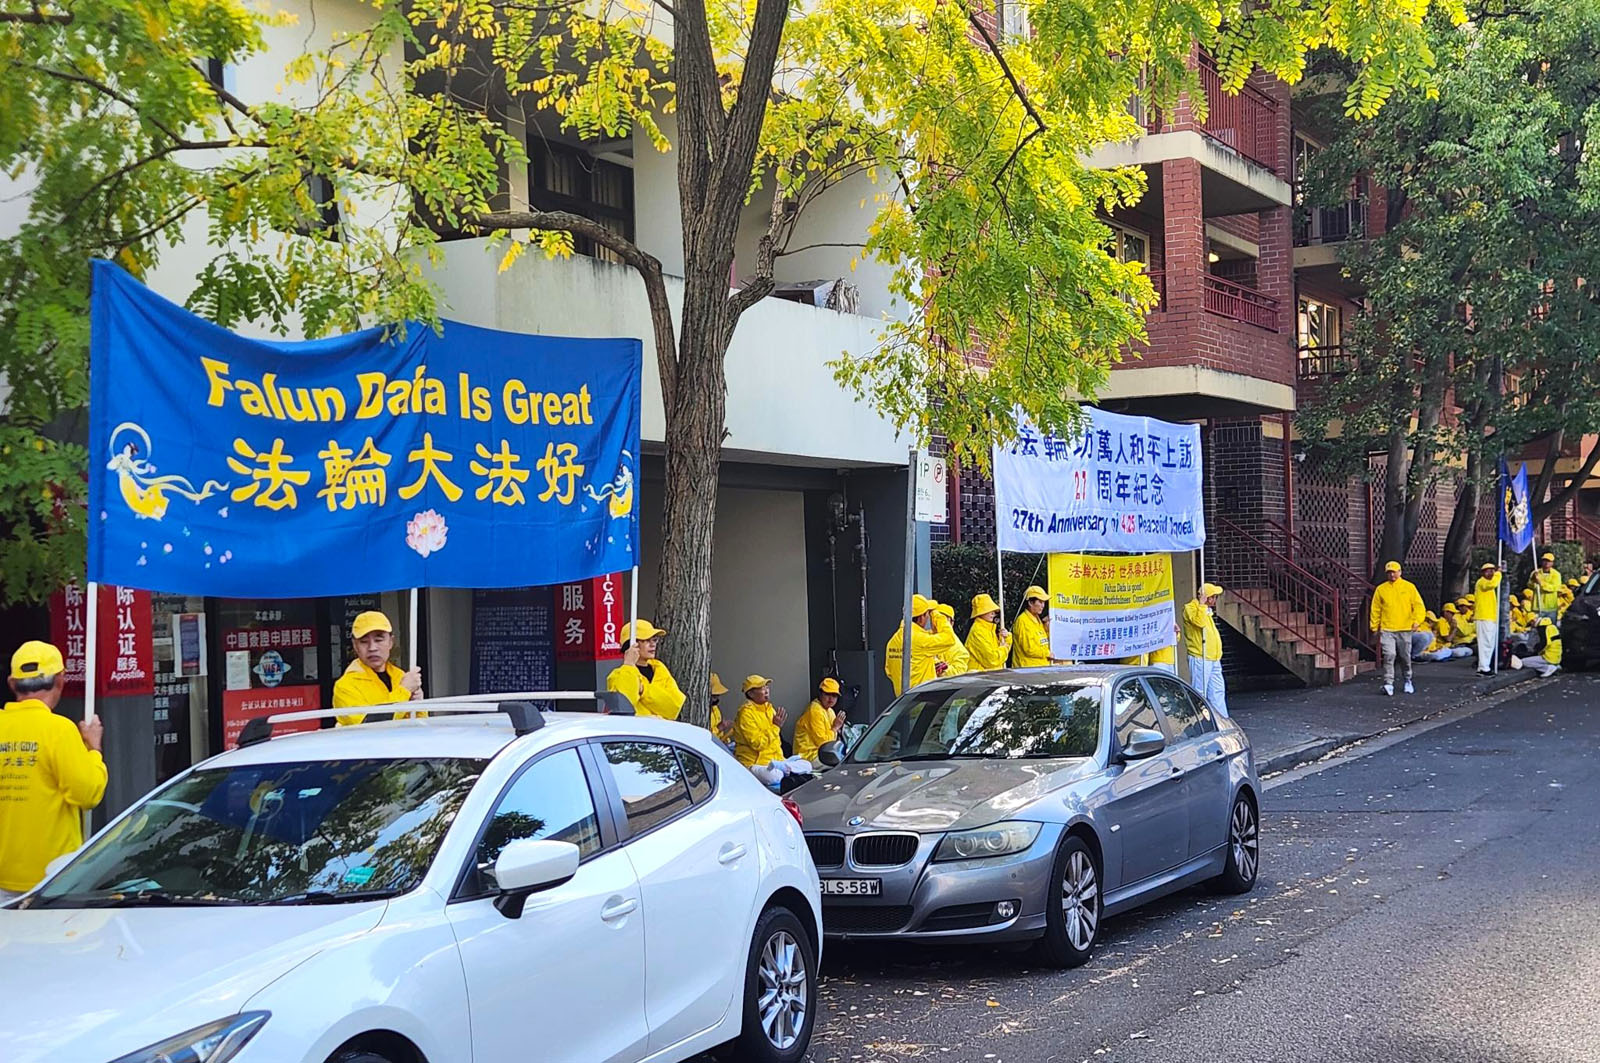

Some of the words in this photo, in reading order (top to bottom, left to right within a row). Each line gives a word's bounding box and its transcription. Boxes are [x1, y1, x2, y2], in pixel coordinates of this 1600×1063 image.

[200, 356, 346, 422] Falun
[355, 365, 447, 420] Dafa
[459, 372, 492, 422] Is
[503, 378, 594, 425] Great
[227, 432, 585, 512] 法輪大法好
[1097, 469, 1164, 506] 周年紀念
[1012, 508, 1044, 533] 27th
[1047, 511, 1109, 536] Anniversary
[1057, 593, 1070, 604] The
[1072, 594, 1089, 605] World
